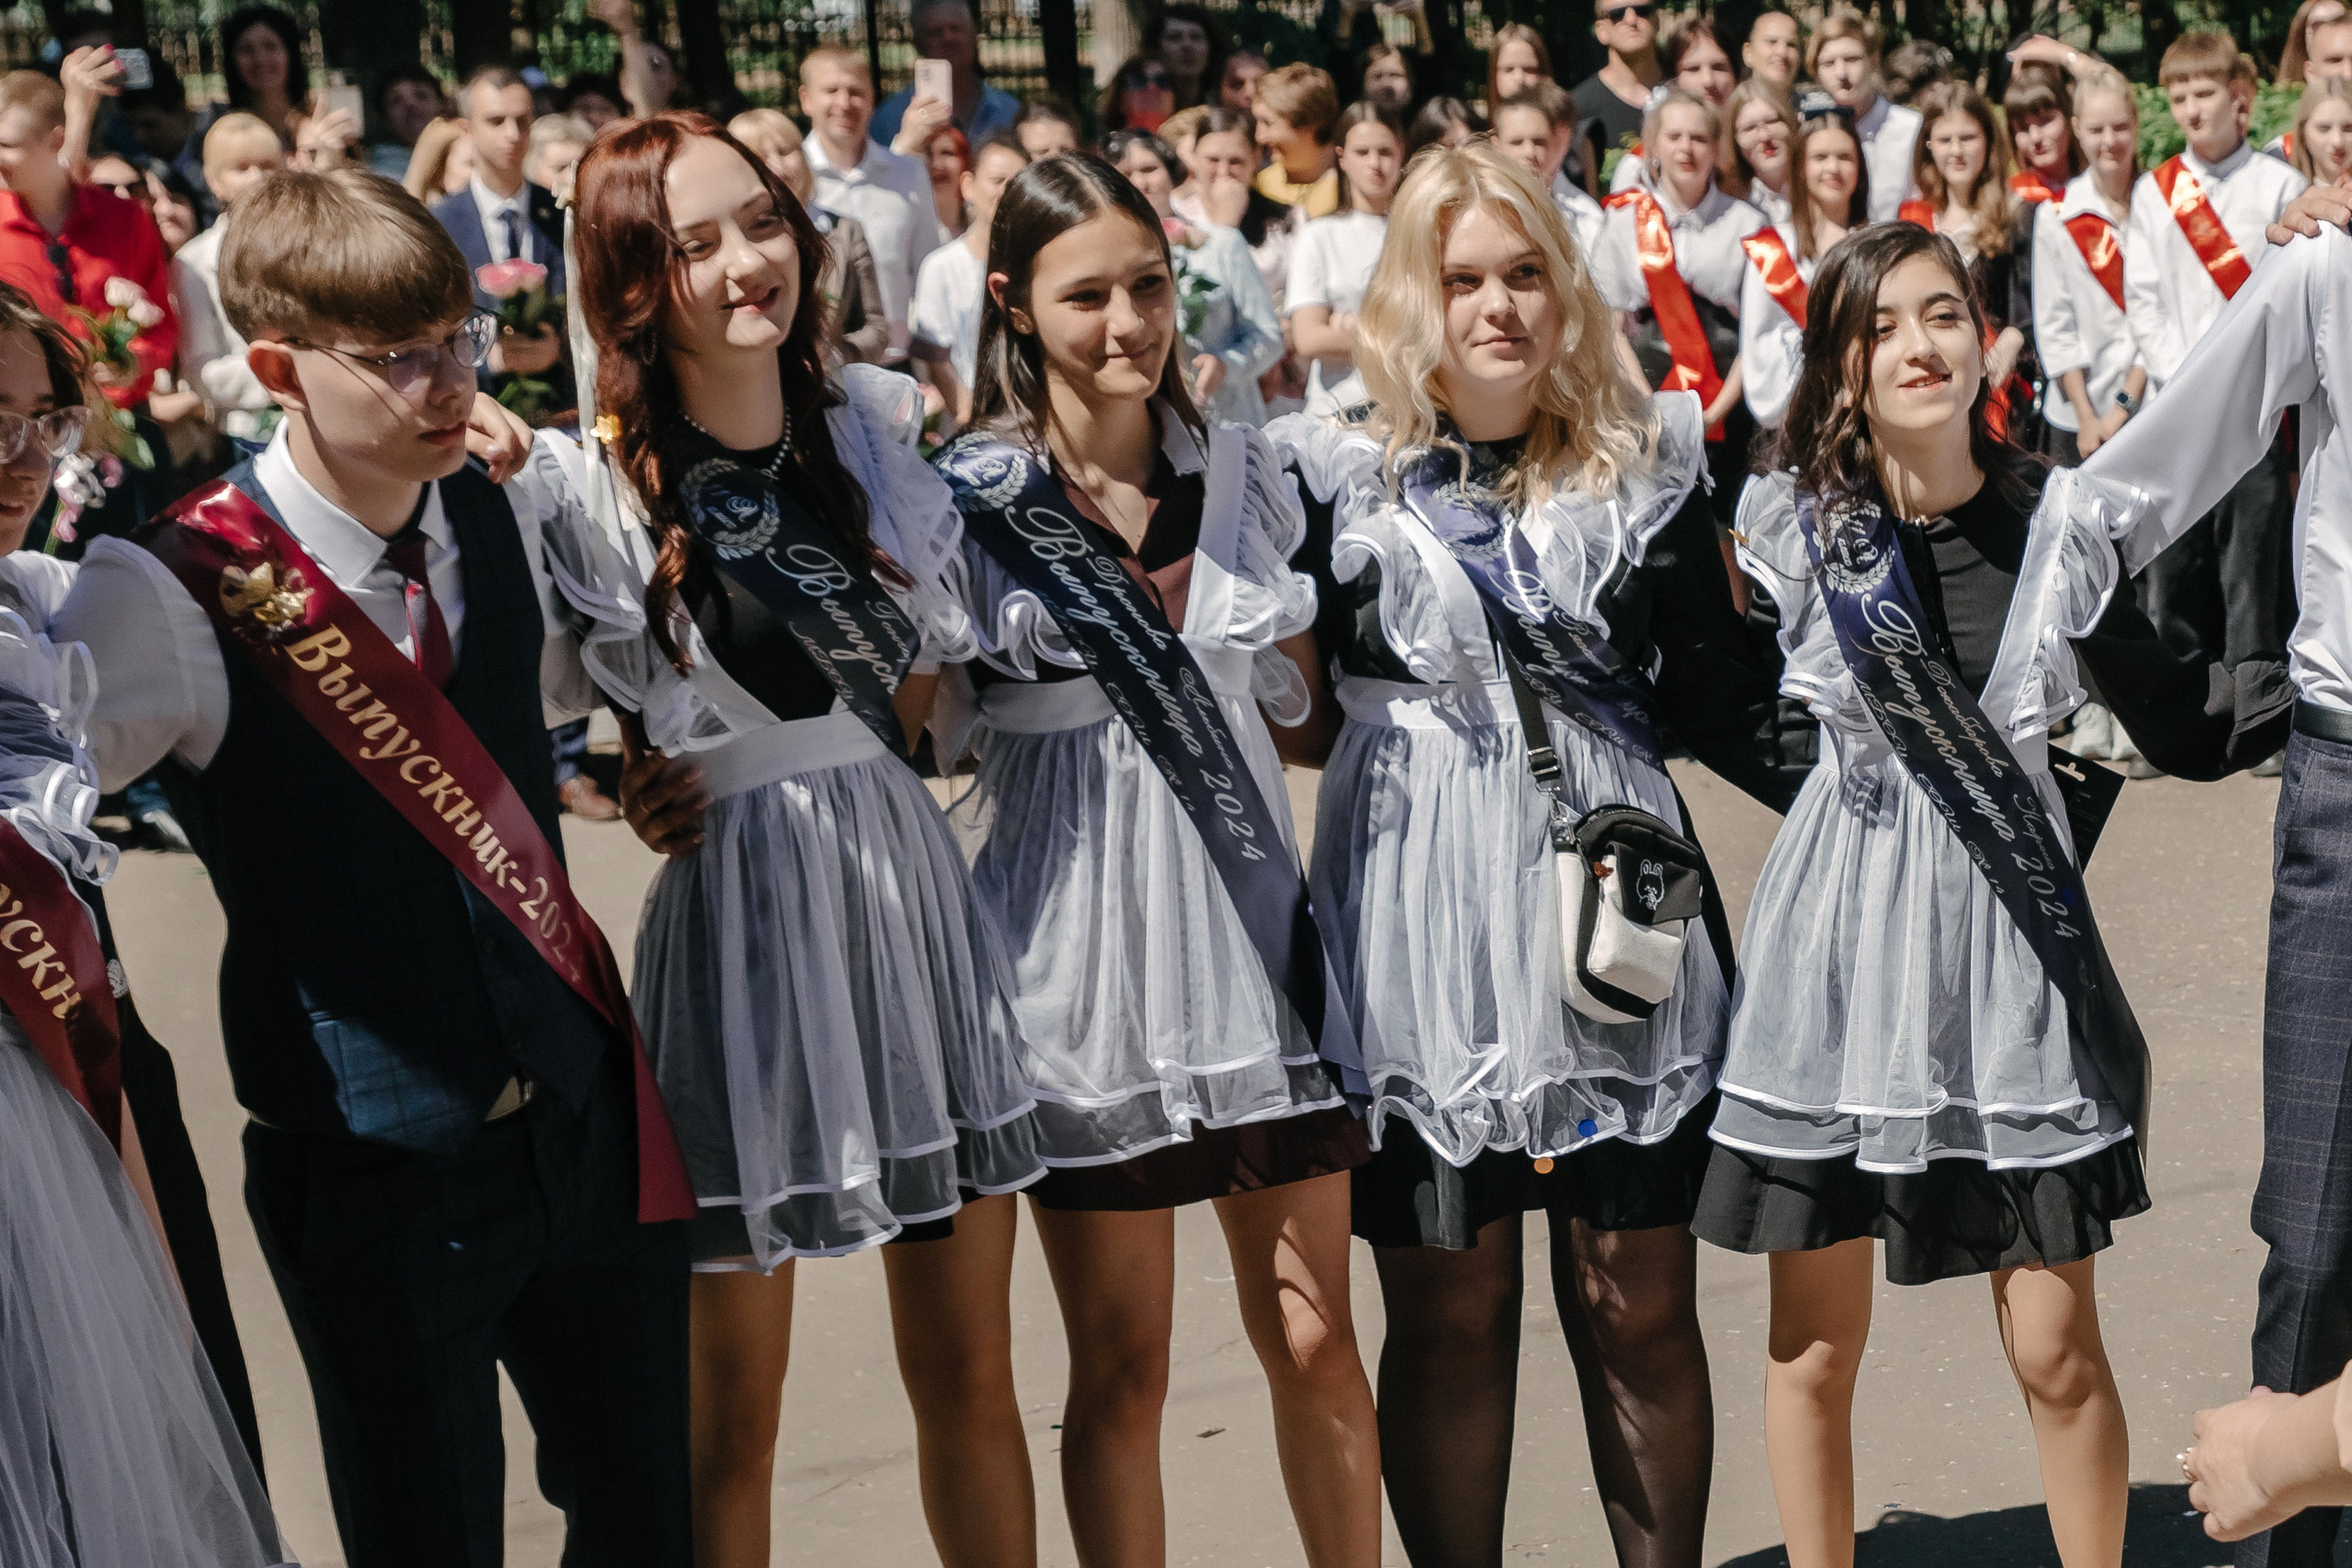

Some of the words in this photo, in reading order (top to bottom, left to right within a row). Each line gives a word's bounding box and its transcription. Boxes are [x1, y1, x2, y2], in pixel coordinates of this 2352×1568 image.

[1004, 505, 1203, 758] Выпускница
[1198, 769, 1267, 862] 2024
[1086, 555, 1168, 651] Дронова
[1860, 592, 2015, 842] Выпускница
[2010, 851, 2081, 939] 2024
